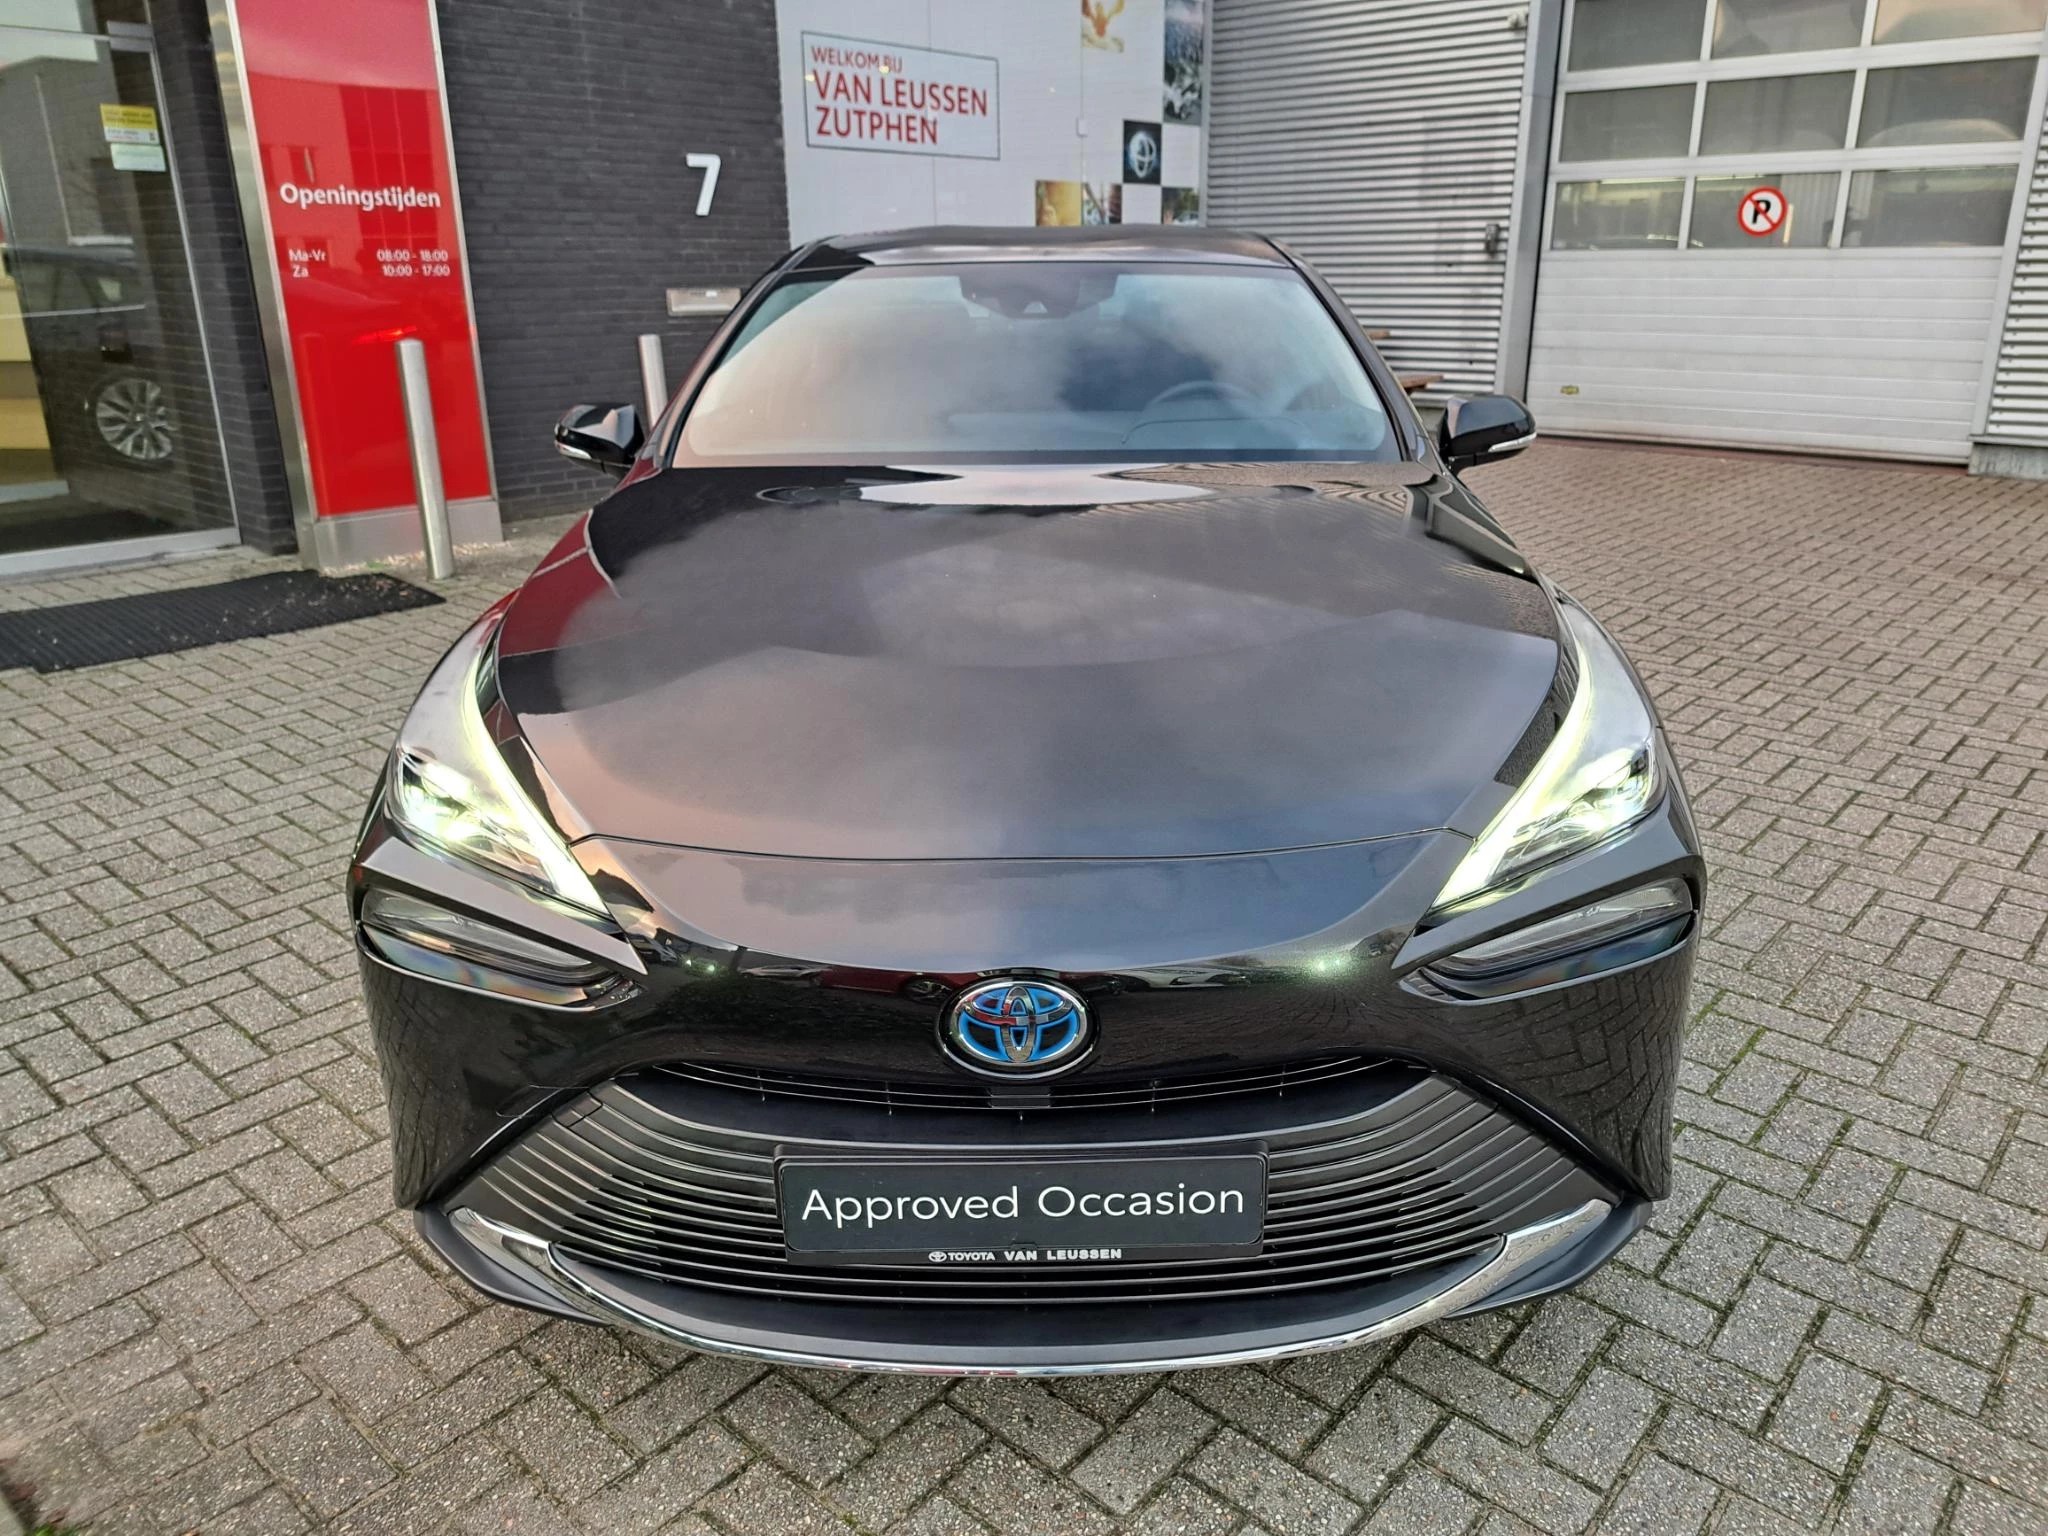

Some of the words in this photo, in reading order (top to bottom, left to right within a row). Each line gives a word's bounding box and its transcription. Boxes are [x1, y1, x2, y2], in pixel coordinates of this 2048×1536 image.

[811, 46, 880, 70] WELKOM
[813, 69, 872, 104] VAN
[880, 77, 989, 117] LEUSSEN
[816, 105, 938, 145] ZUTPHEN
[279, 182, 442, 212] Openingstijden
[686, 153, 722, 217] 7
[288, 250, 327, 262] Ma-Vr
[376, 250, 410, 262] 08:00
[420, 250, 449, 262] 18:00
[292, 265, 310, 278] Za
[382, 265, 413, 276] 10:00
[422, 265, 451, 276] 17:00
[801, 1185, 1020, 1230] Approved
[1038, 1182, 1244, 1217] Occasion
[948, 1251, 997, 1262] TOYOTA
[1004, 1250, 1038, 1262] VAN
[1046, 1248, 1123, 1260] LEUSSEN
